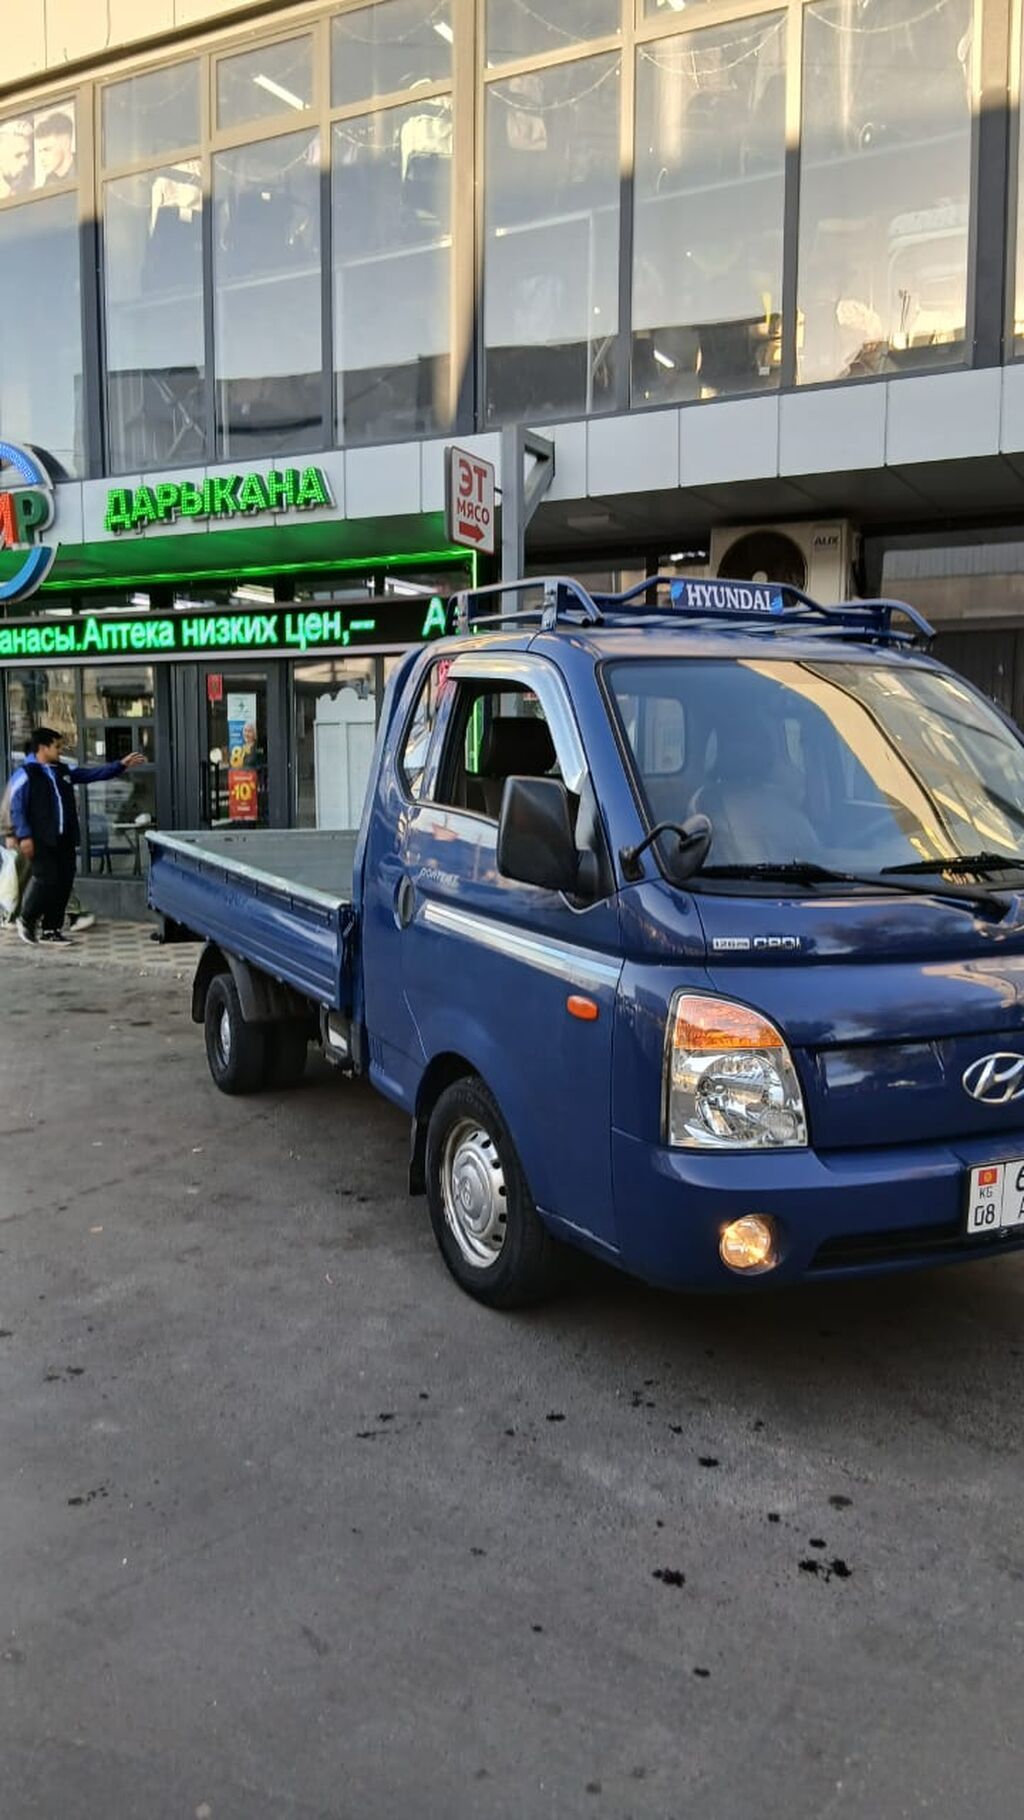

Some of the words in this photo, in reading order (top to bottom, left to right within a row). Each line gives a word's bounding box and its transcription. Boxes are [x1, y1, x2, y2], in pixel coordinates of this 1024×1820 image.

[459, 459, 487, 503] ЭТ
[103, 466, 328, 532] ДАРЫКАНА
[457, 498, 490, 525] МЯСО
[686, 583, 772, 611] HYUNDAI
[181, 614, 278, 647] низких
[974, 1203, 995, 1226] 08
